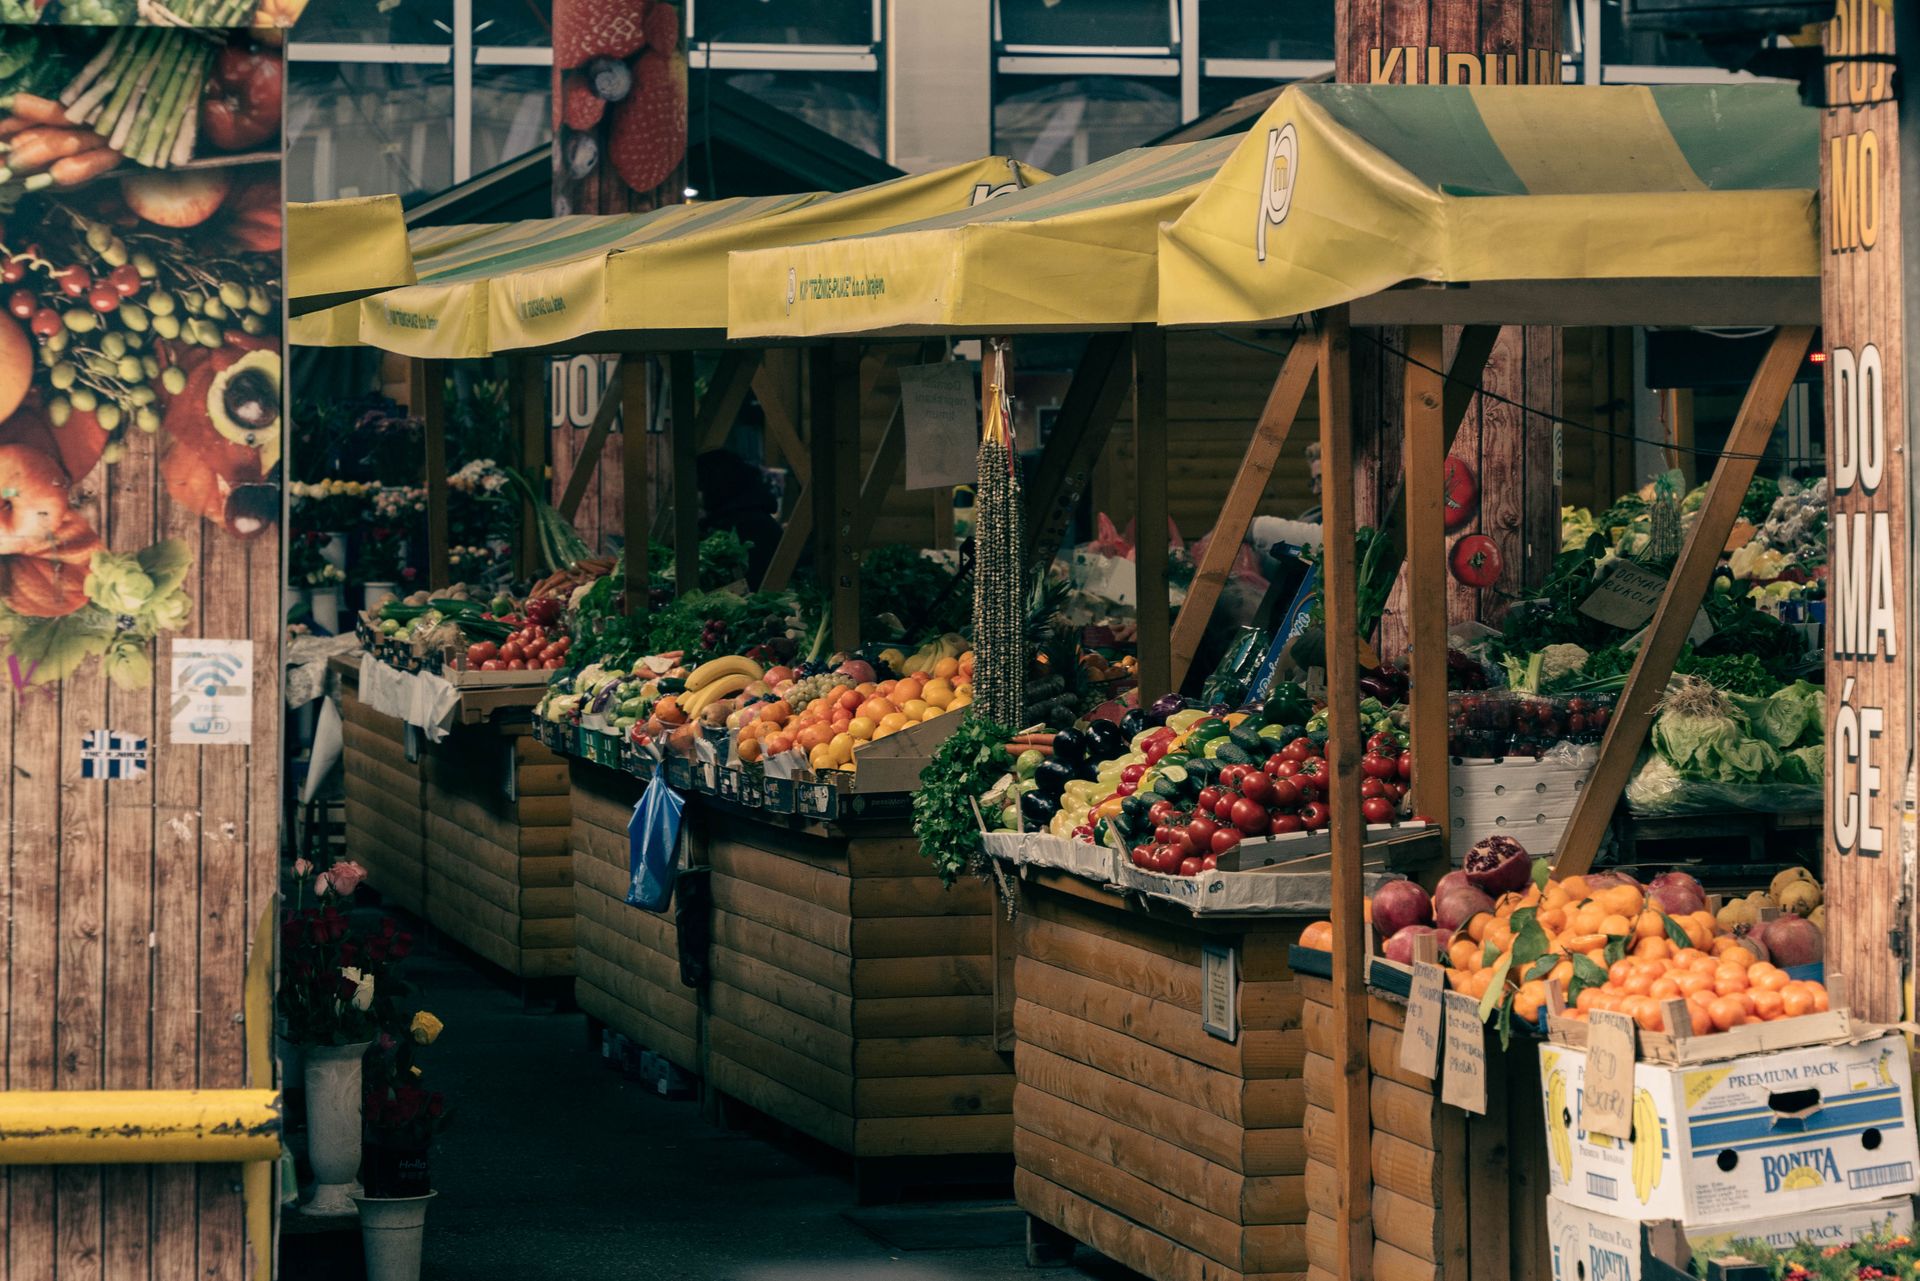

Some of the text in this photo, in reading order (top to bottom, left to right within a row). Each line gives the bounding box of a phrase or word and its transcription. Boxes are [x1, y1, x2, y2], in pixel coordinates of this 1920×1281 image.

[1728, 1061, 1841, 1089] PREMIUM PACK
[1760, 1146, 1844, 1194] BONITA
[1806, 1225, 1844, 1241] PACK
